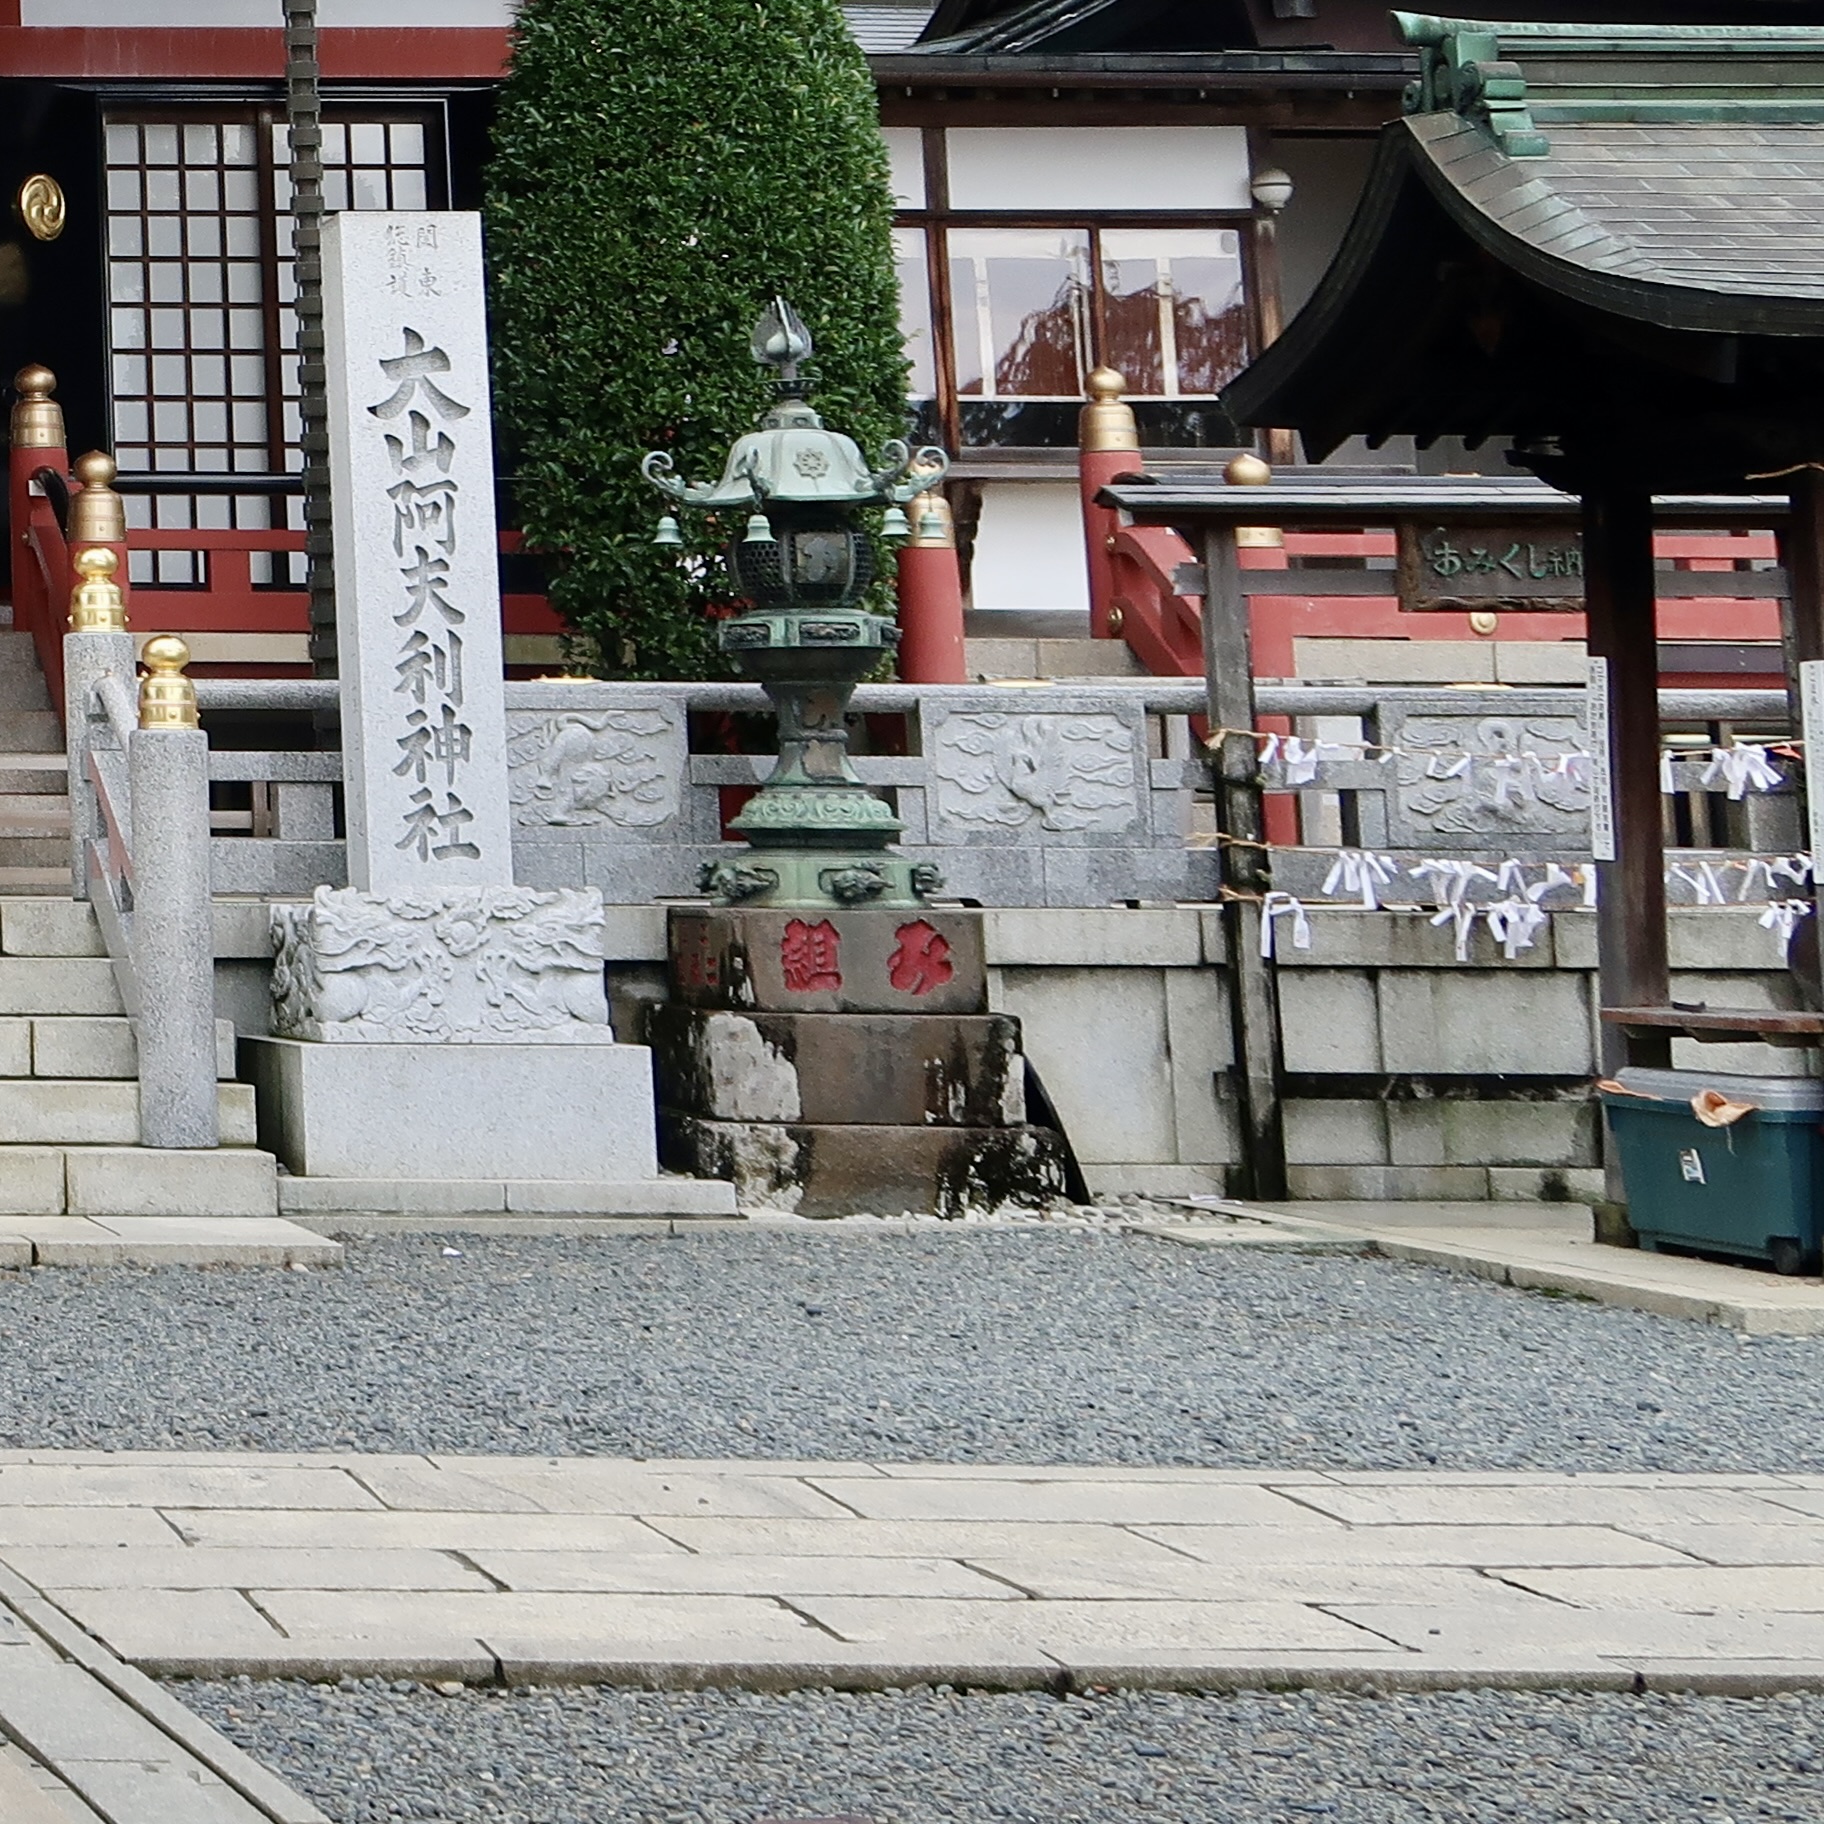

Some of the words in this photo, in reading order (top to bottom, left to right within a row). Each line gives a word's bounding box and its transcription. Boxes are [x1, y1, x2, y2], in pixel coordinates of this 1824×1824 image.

[366, 325, 483, 865] 大山阿夫利神社
